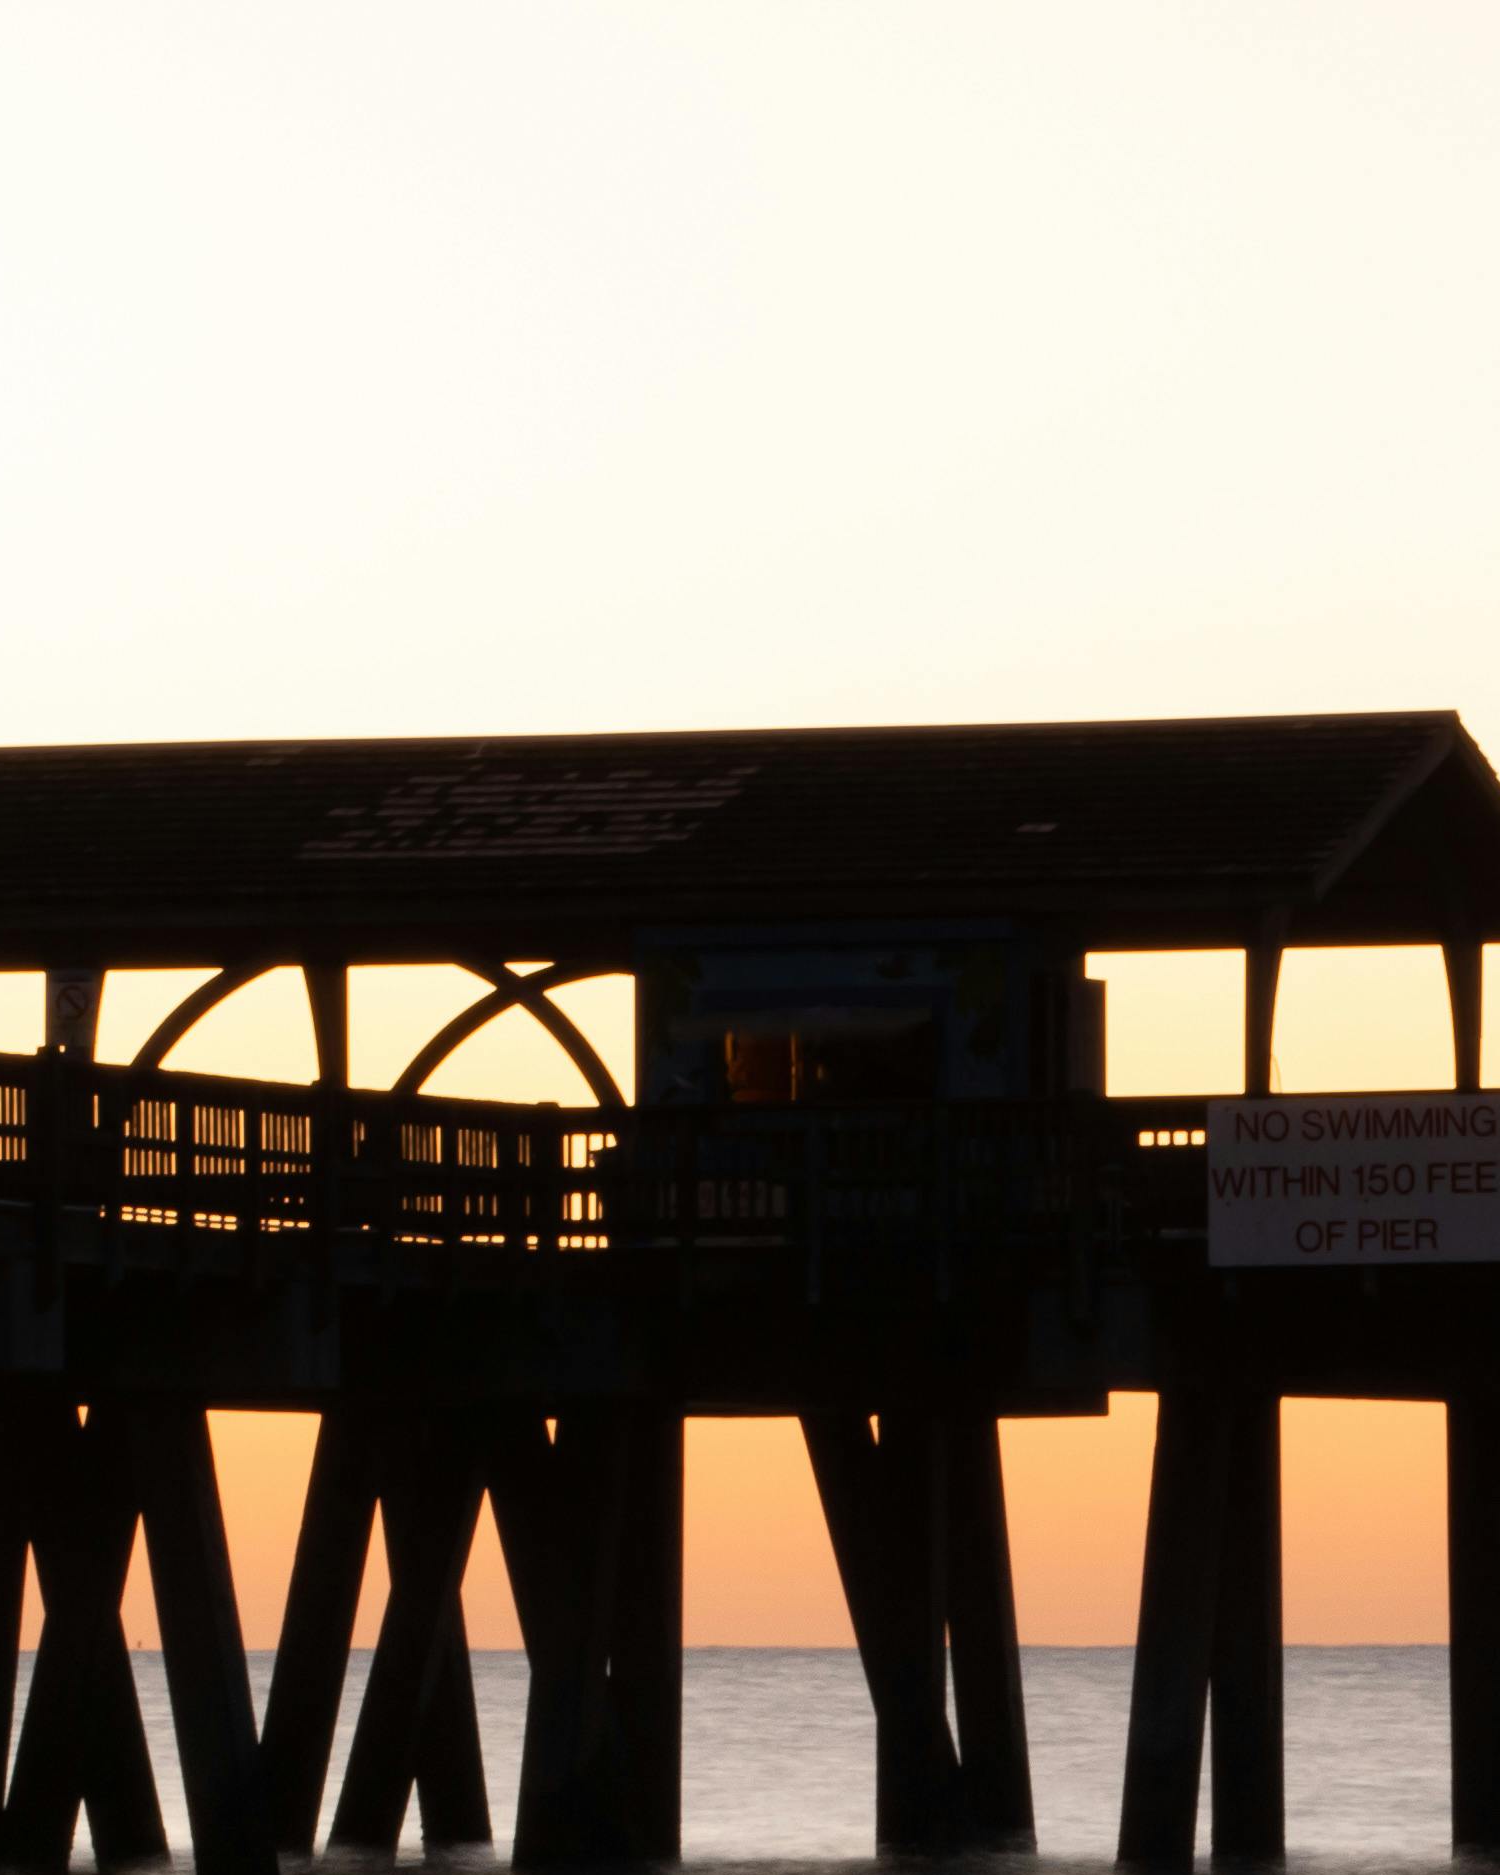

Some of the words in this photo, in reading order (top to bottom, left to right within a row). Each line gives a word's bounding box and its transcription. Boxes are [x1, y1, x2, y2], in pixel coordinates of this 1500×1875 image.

[1235, 1111, 1289, 1141] NO
[1302, 1105, 1496, 1140] SWIMMING
[1212, 1166, 1339, 1198] WITHIN
[1352, 1164, 1414, 1195] 150
[1296, 1220, 1346, 1252] OF
[1358, 1218, 1438, 1250] PIER
